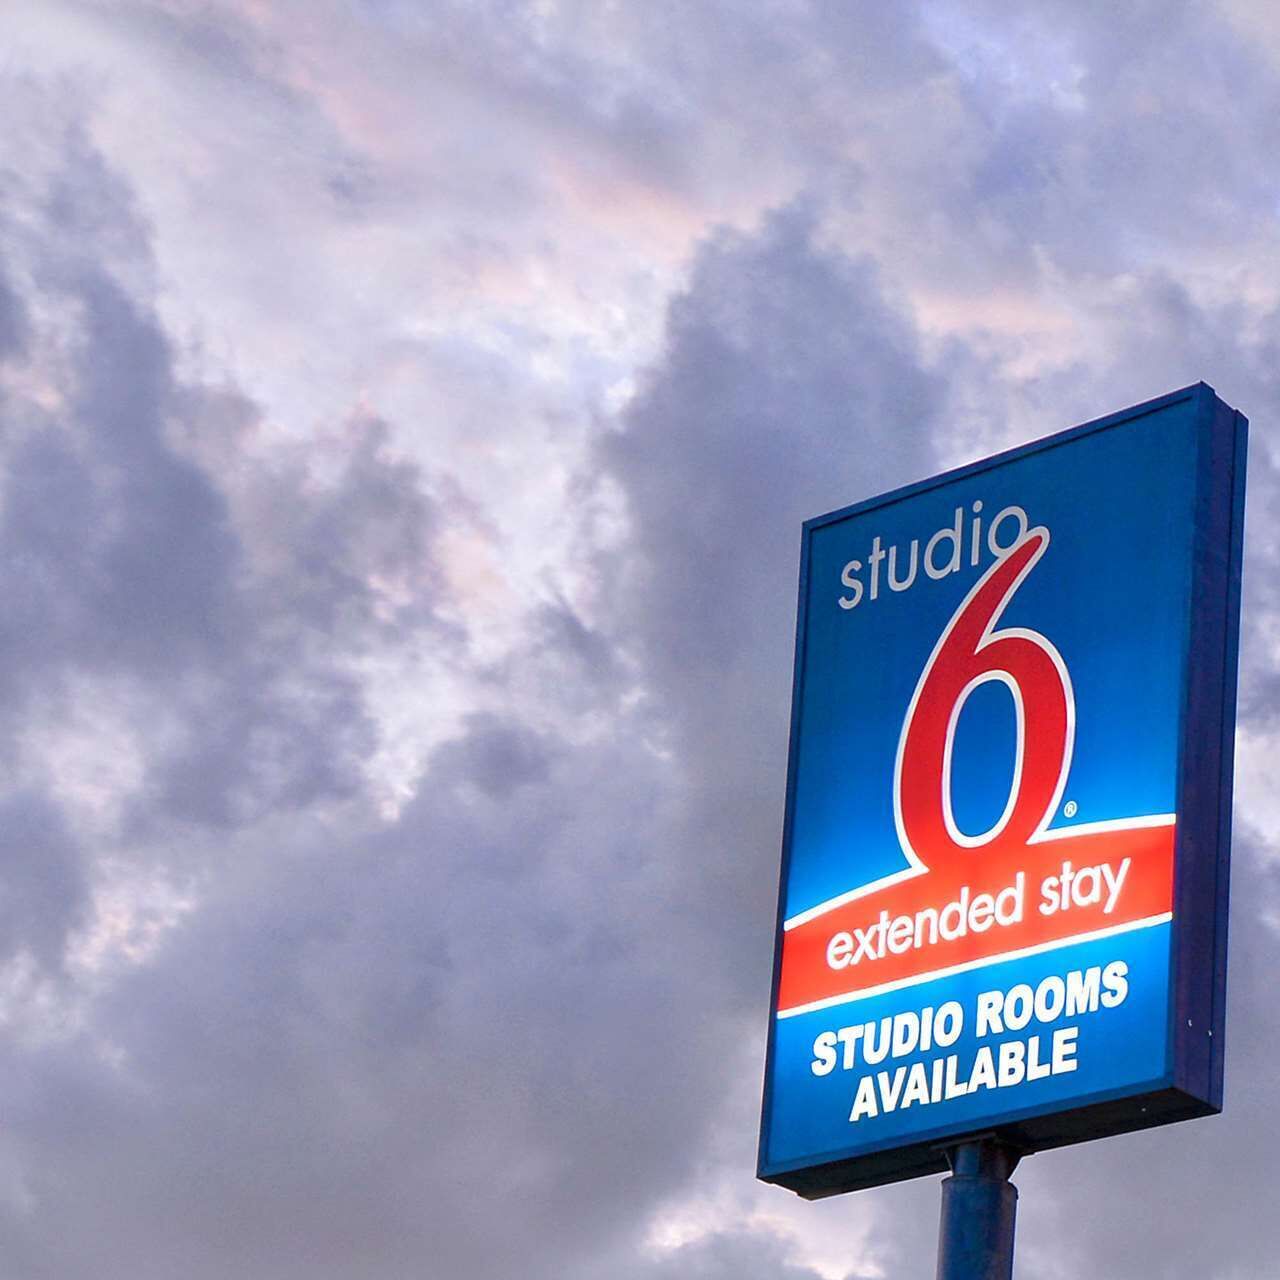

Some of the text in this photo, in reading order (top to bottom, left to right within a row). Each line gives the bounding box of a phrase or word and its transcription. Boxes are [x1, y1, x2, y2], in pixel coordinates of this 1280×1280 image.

[837, 500, 1029, 610] studio
[893, 525, 1076, 872] 6
[826, 857, 1132, 970] extended stay
[811, 960, 1129, 1077] STUDIO ROOMS
[848, 1027, 1080, 1123] AVAILABLE
